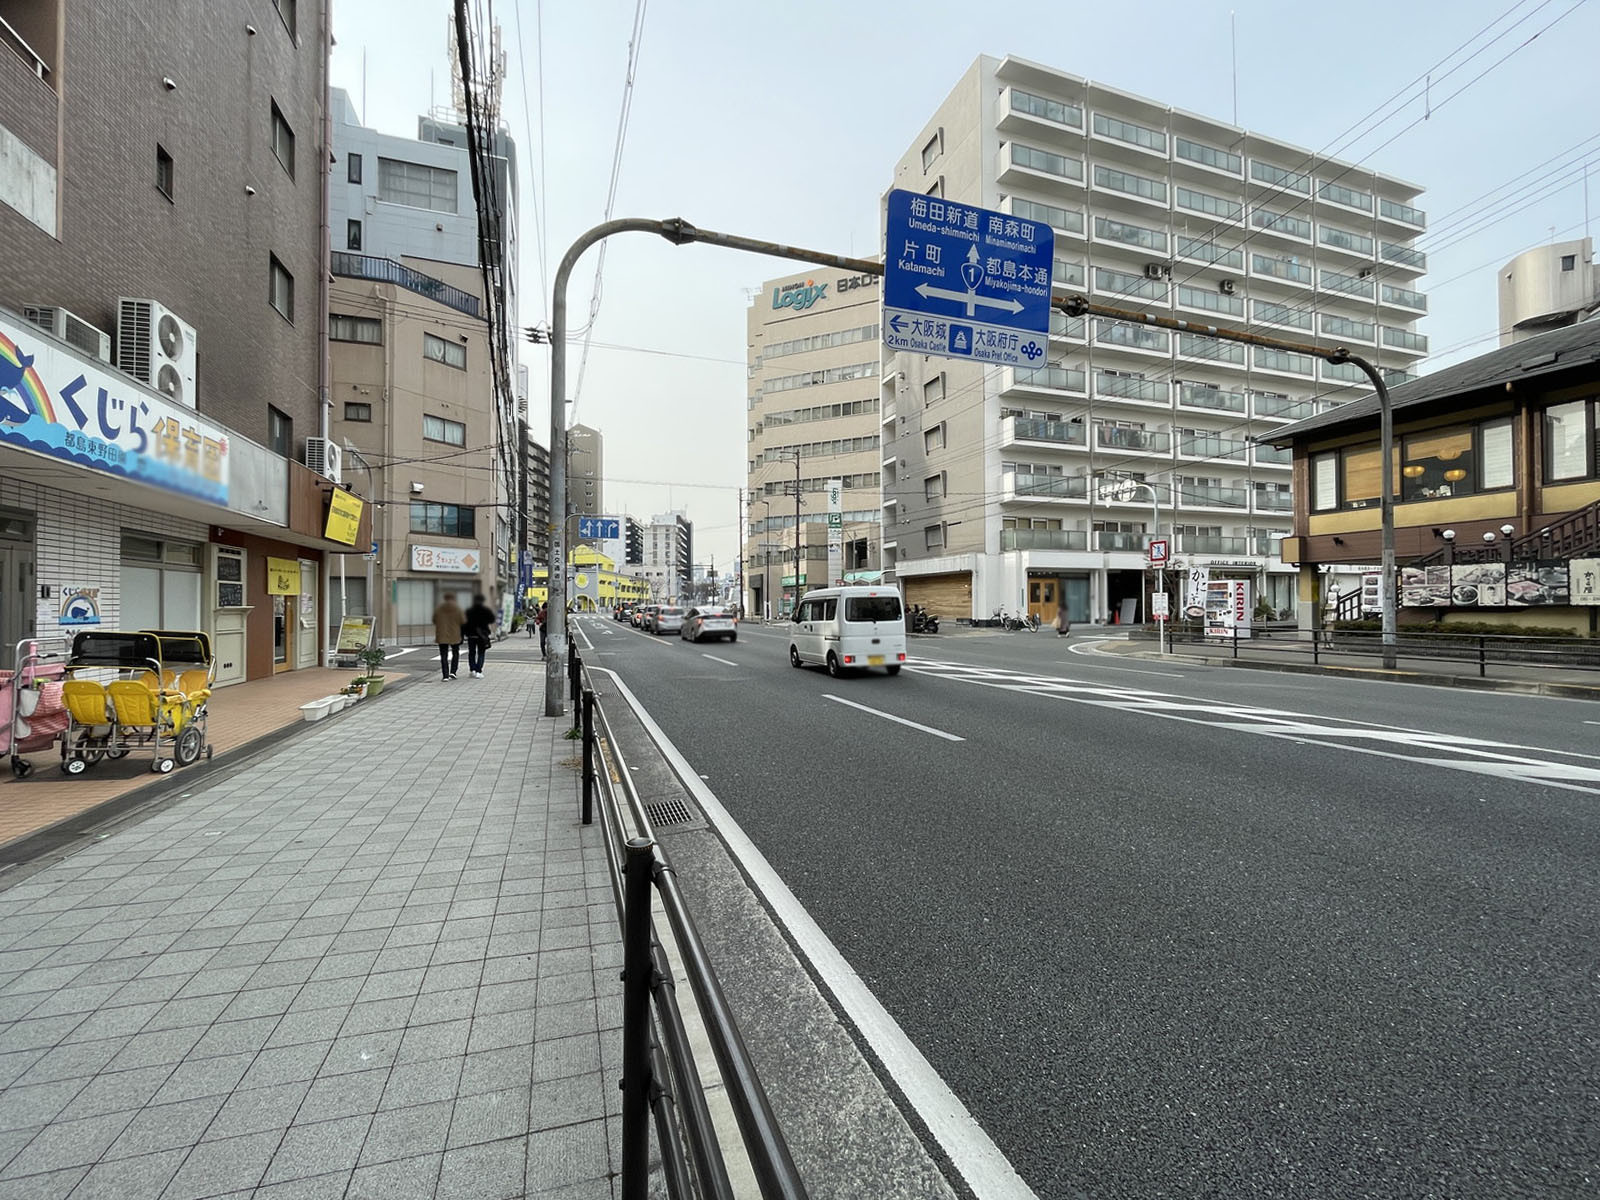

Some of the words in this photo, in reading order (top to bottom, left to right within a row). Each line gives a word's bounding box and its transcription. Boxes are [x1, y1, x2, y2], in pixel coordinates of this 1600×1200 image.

[911, 197, 978, 230] 梅田新道
[988, 216, 1035, 243] 南森町
[908, 218, 980, 243] Umeda-shimmichi
[985, 234, 1037, 254] Minamimorimachi
[898, 258, 945, 277] Katamachi
[968, 267, 975, 283] 1
[986, 256, 1048, 286] 都島本通
[772, 279, 829, 311] Logix
[984, 275, 1048, 297] Miyakojima-hondori
[911, 318, 947, 341] 大阪城
[975, 328, 1019, 351] 大阪府庁
[888, 334, 909, 347] 2km
[910, 338, 928, 350] Osaka
[928, 341, 946, 353] Castle
[974, 347, 990, 359] Osaka
[416, 549, 434, 567] 花
[1236, 582, 1244, 622] KIRIN
